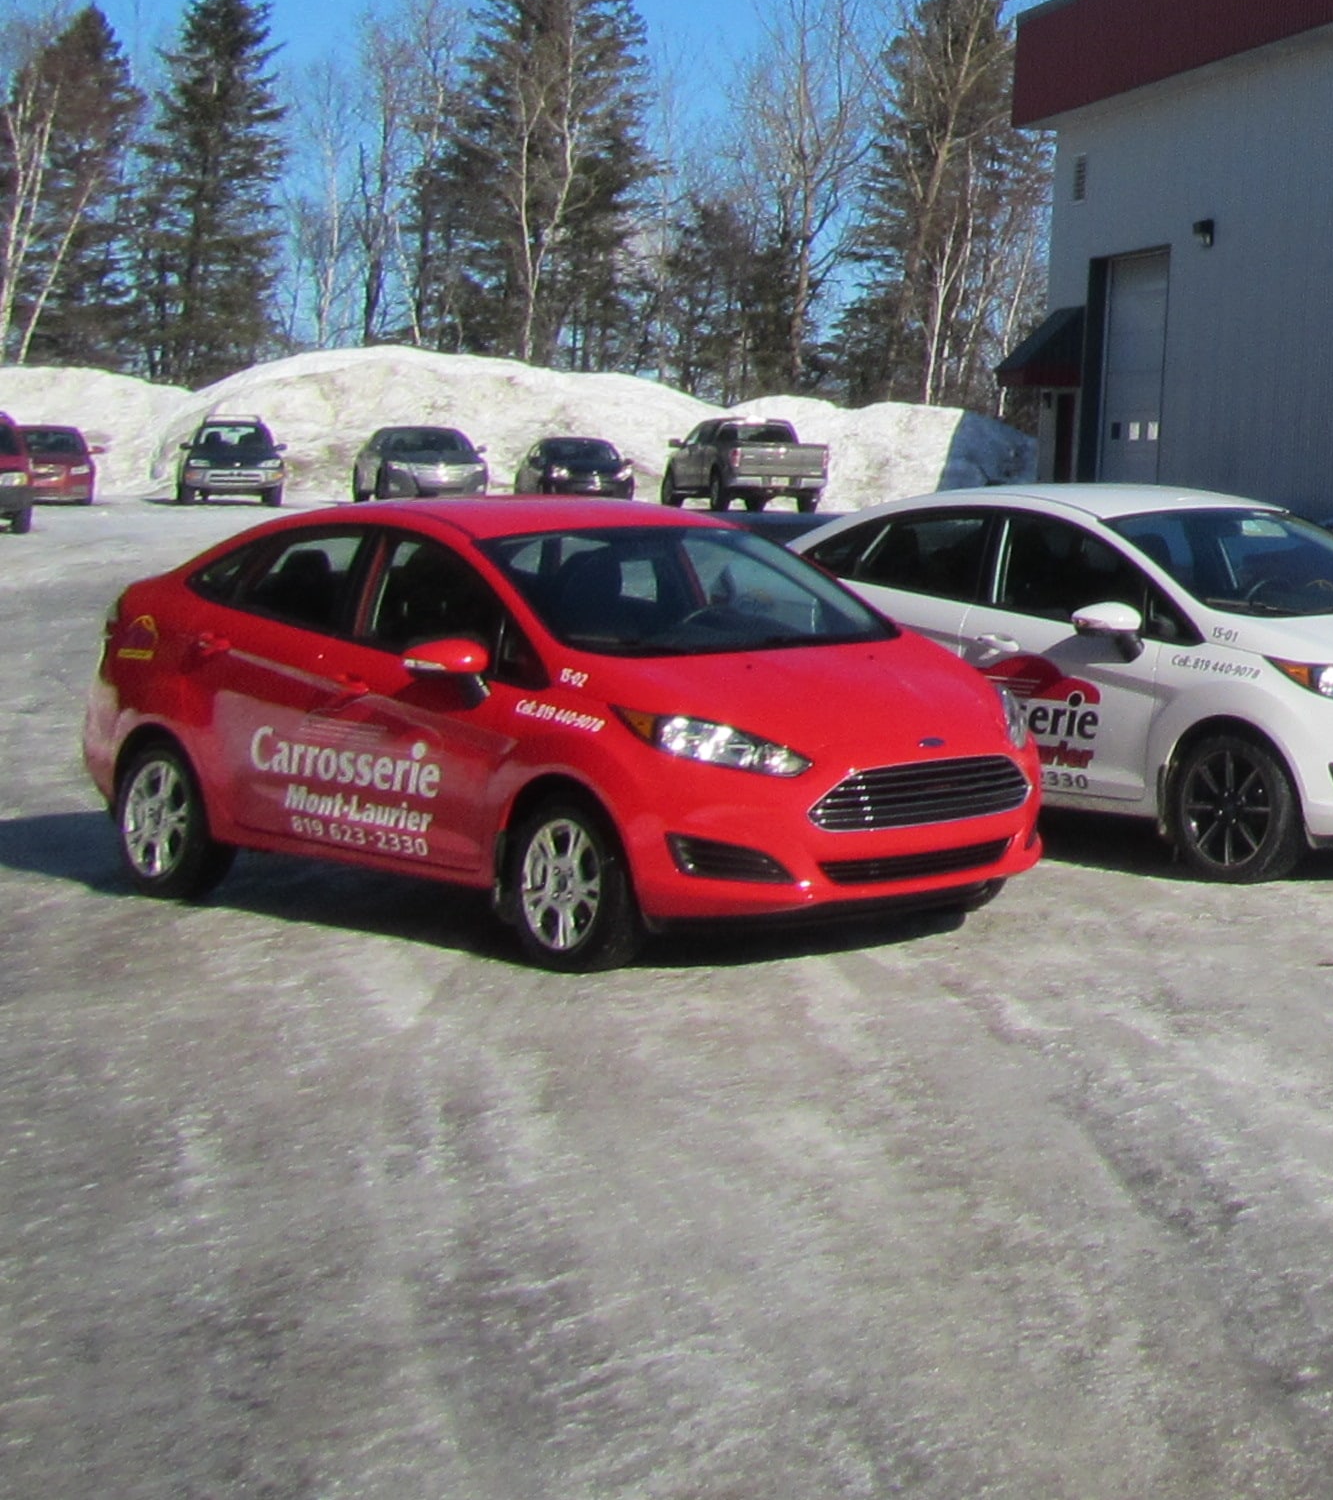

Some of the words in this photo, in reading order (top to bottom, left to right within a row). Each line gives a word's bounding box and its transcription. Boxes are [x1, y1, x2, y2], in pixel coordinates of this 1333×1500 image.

[251, 725, 441, 798] Carrosserie
[284, 783, 433, 833] Mont-Laurier
[291, 815, 325, 837] 819
[329, 822, 429, 857] 623-2330
